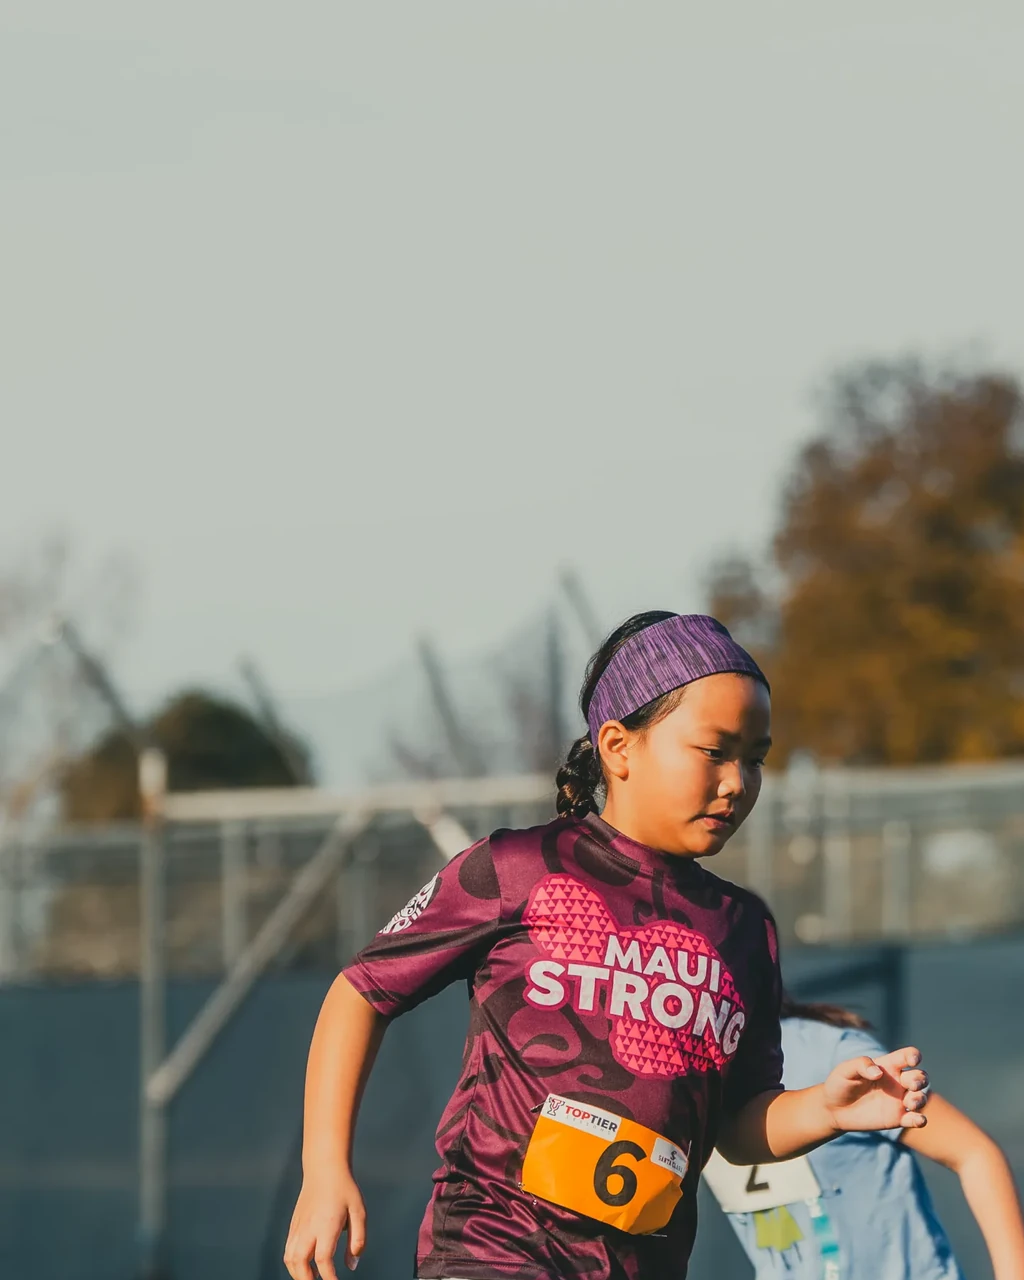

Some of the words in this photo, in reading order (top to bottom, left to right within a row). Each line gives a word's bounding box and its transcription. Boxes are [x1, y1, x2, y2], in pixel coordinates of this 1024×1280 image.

[604, 935, 721, 993] MAUI
[527, 960, 746, 1055] STRONG
[565, 1105, 618, 1132] TOPTIER
[593, 1140, 647, 1207] 6
